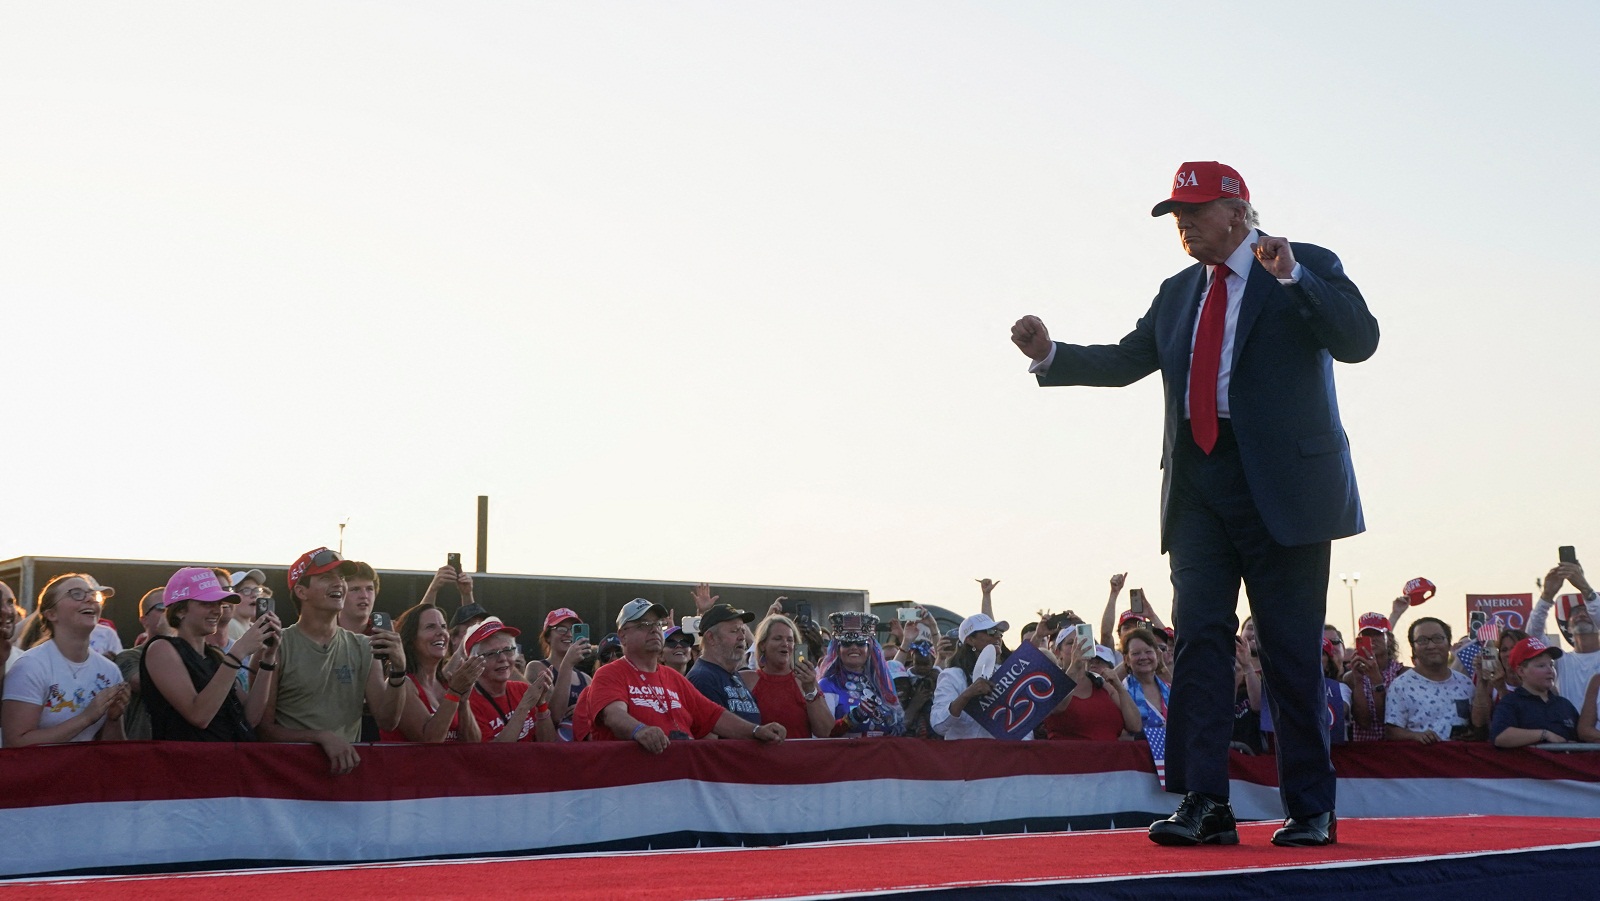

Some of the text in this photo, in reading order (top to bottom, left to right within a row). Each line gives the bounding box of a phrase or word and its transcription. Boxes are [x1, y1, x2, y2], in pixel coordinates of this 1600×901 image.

[1174, 171, 1199, 189] SA
[1475, 598, 1524, 608] AMERICA
[979, 658, 1031, 712] AMERICA
[990, 671, 1055, 733] 250
